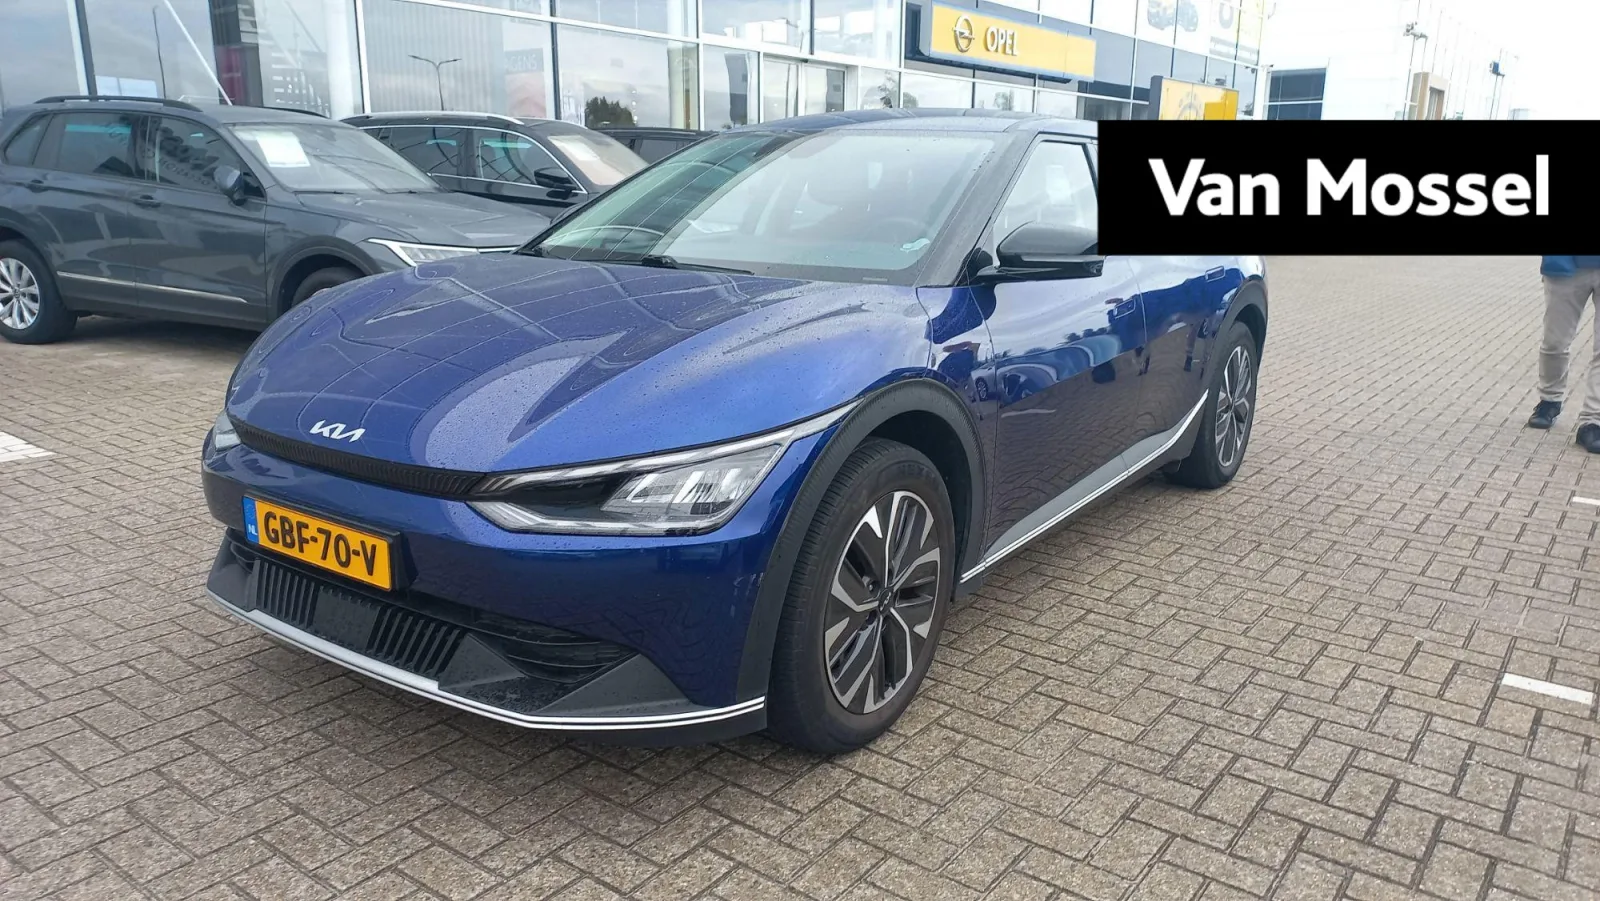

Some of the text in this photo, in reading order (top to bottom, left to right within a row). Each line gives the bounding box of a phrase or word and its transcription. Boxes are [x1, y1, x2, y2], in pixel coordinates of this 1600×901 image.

[985, 26, 1018, 56] OPEL
[309, 419, 366, 443] KIA
[247, 523, 258, 536] NL
[263, 510, 377, 577] GBF-70-V
